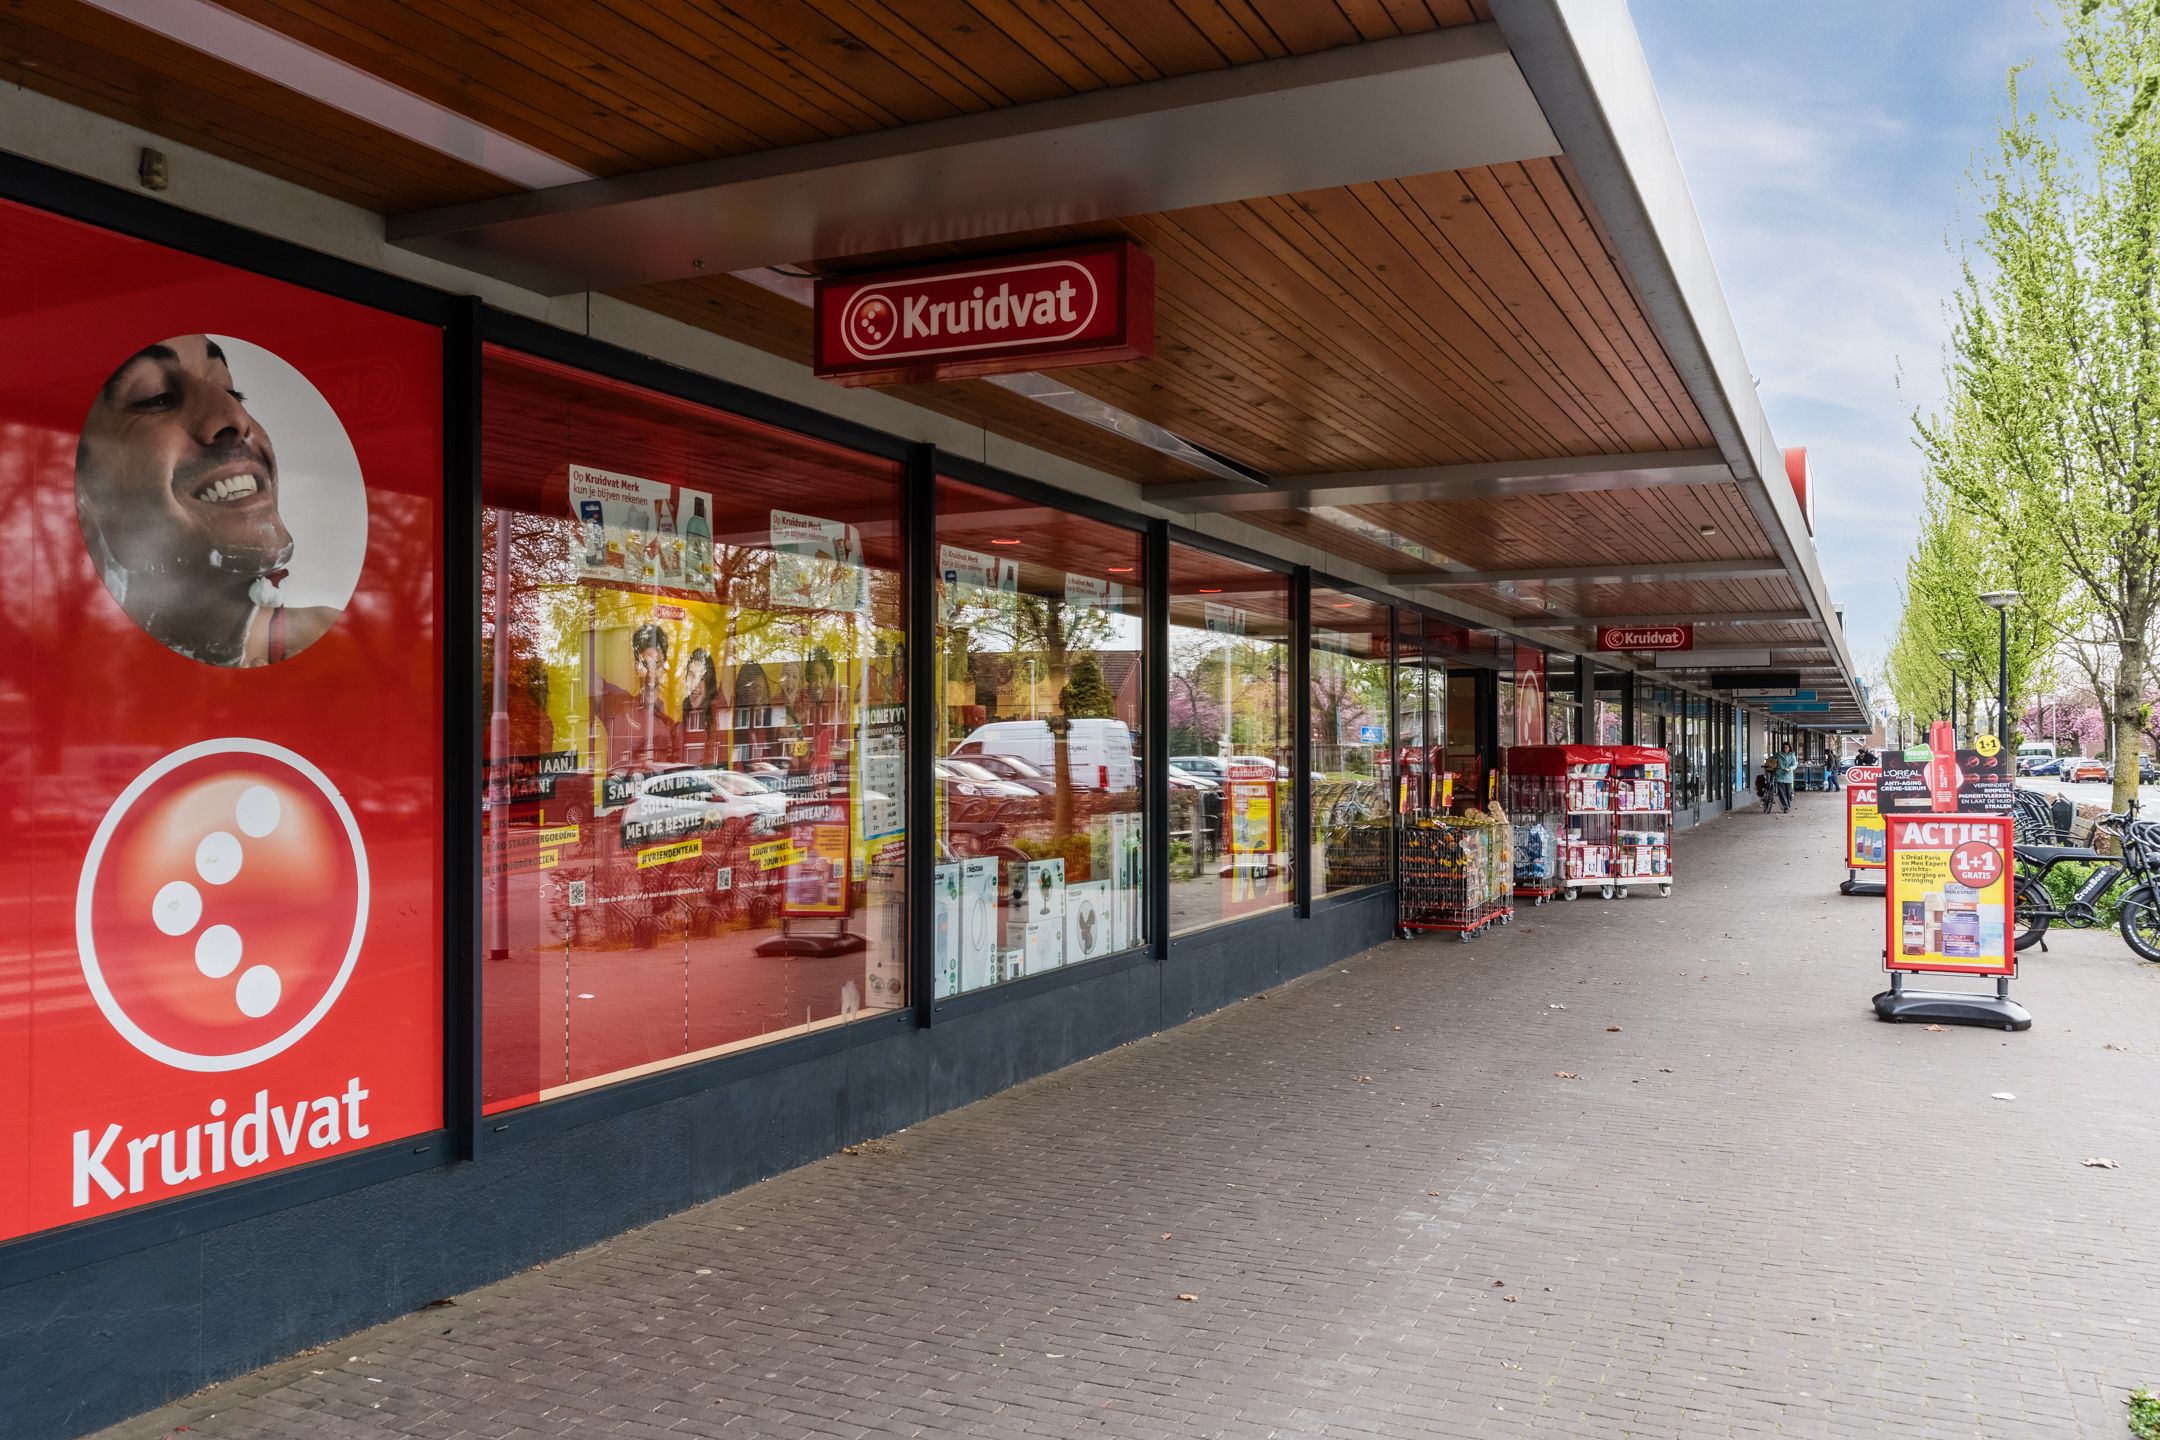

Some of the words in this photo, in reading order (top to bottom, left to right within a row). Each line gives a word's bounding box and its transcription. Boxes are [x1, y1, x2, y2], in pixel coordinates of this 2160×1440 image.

[903, 280, 1077, 338] Kruidvat
[574, 471, 583, 483] Op
[586, 473, 619, 488] Kruidvat
[621, 480, 640, 492] Merk
[574, 483, 587, 495] kun
[589, 486, 596, 498] je
[598, 488, 620, 501] blijven
[622, 493, 648, 506] rekenen
[782, 516, 807, 529] Kruidvat
[808, 521, 823, 531] Merk
[1625, 631, 1679, 644] Kruidvat
[1979, 739, 1997, 748] 1+1
[626, 822, 649, 840] MET
[650, 817, 663, 835] JE
[665, 812, 702, 832] BESTIE
[1902, 822, 1998, 847] ACTIE!
[641, 843, 700, 865] #VRIENDENTEAM
[752, 847, 769, 856] JOUW
[1955, 851, 1995, 871] 1+1
[2074, 870, 2107, 901] CrossBoss
[73, 1077, 369, 1207] Kruidvat
